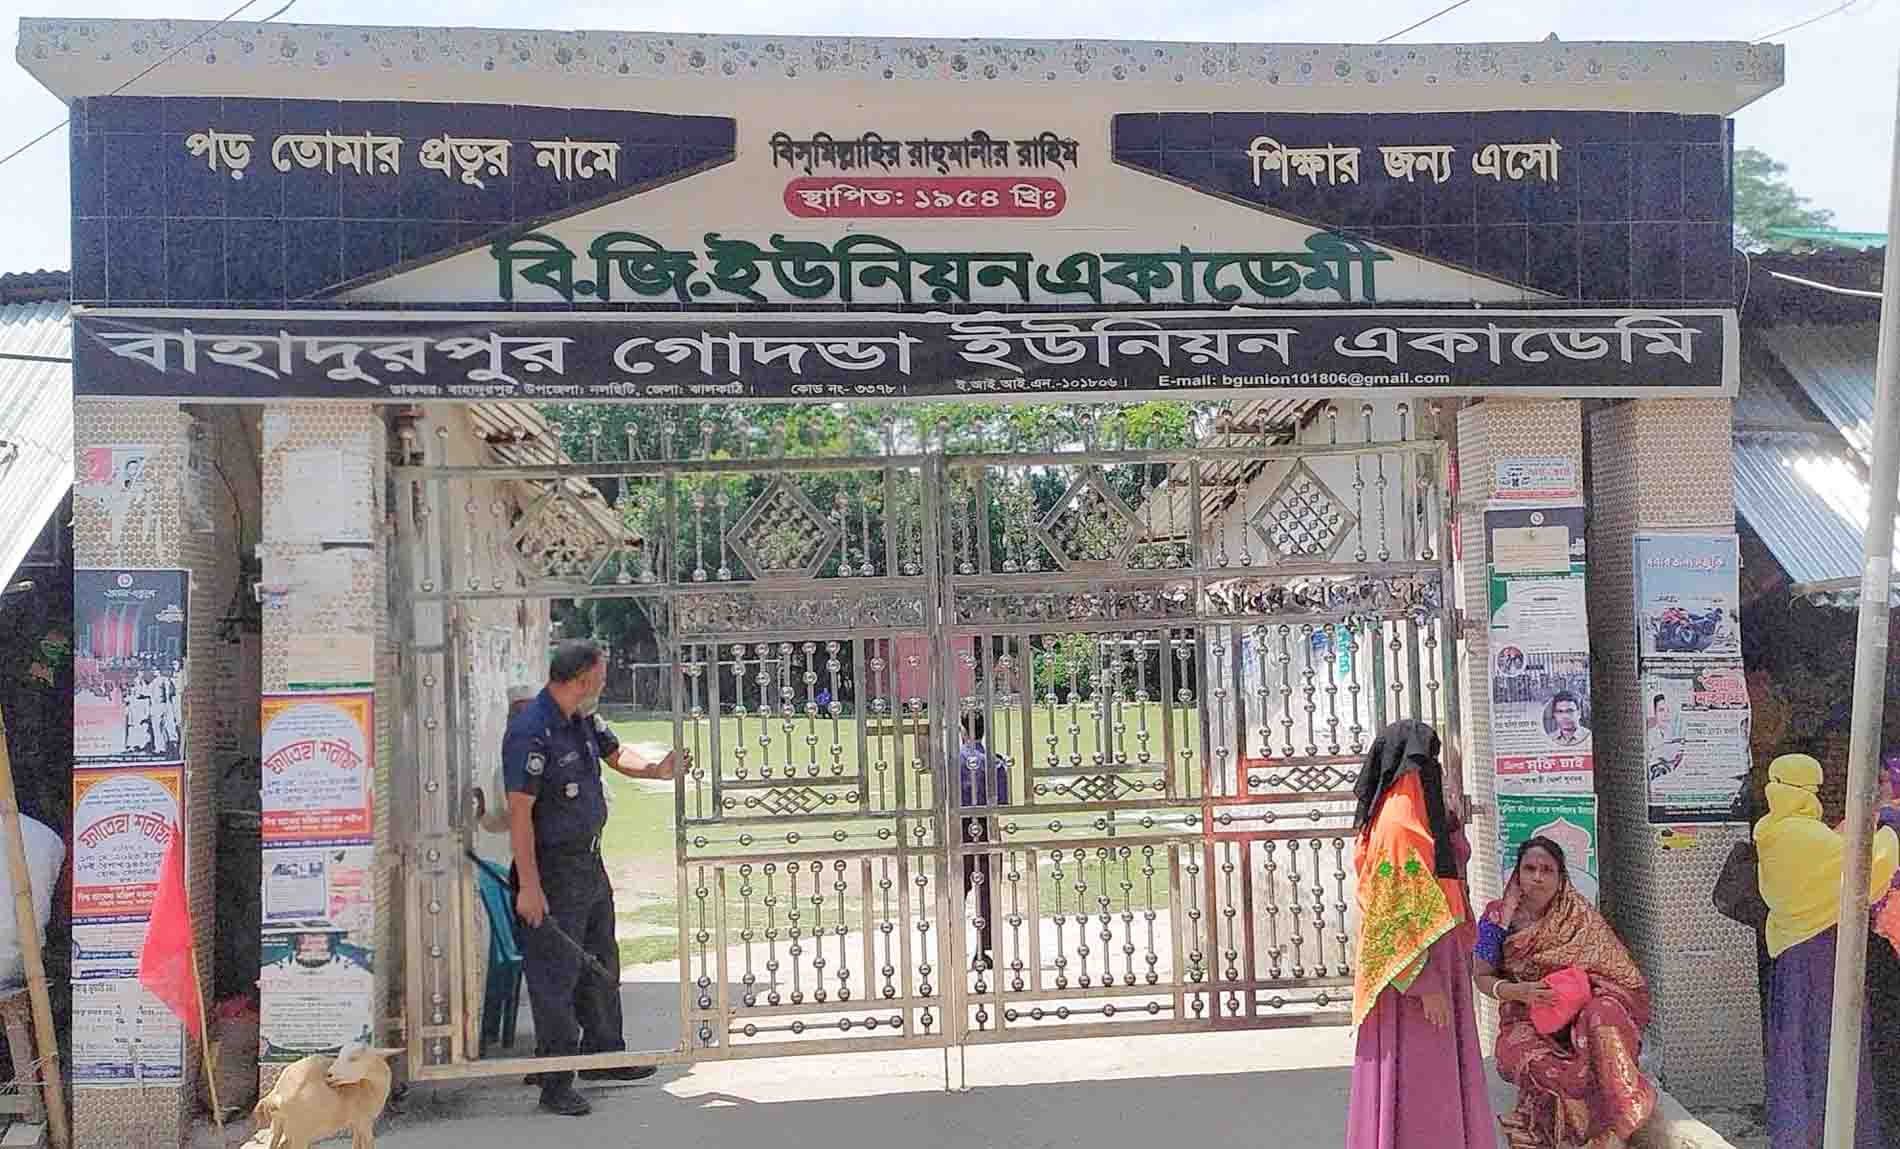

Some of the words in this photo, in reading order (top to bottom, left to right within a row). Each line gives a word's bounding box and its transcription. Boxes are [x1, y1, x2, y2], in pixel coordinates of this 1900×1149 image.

[184, 129, 254, 181] পড়
[272, 131, 401, 175] তোমার
[529, 136, 621, 182] নামে
[1014, 131, 1080, 171] রাহিম
[1247, 136, 1361, 187] শিক্ষার
[1380, 143, 1455, 184] জন্য
[1472, 137, 1562, 183] এসো
[914, 189, 1000, 209] ১৯৫৪
[97, 327, 575, 384] বাহাদুরপুর
[947, 312, 1299, 373] ইউনিয়ন
[1334, 316, 1703, 365] একাডেমি
[791, 384, 824, 395] কোড
[1158, 374, 1217, 387] E-mail:
[1222, 372, 1450, 387] bgunion101806@gmail.com
